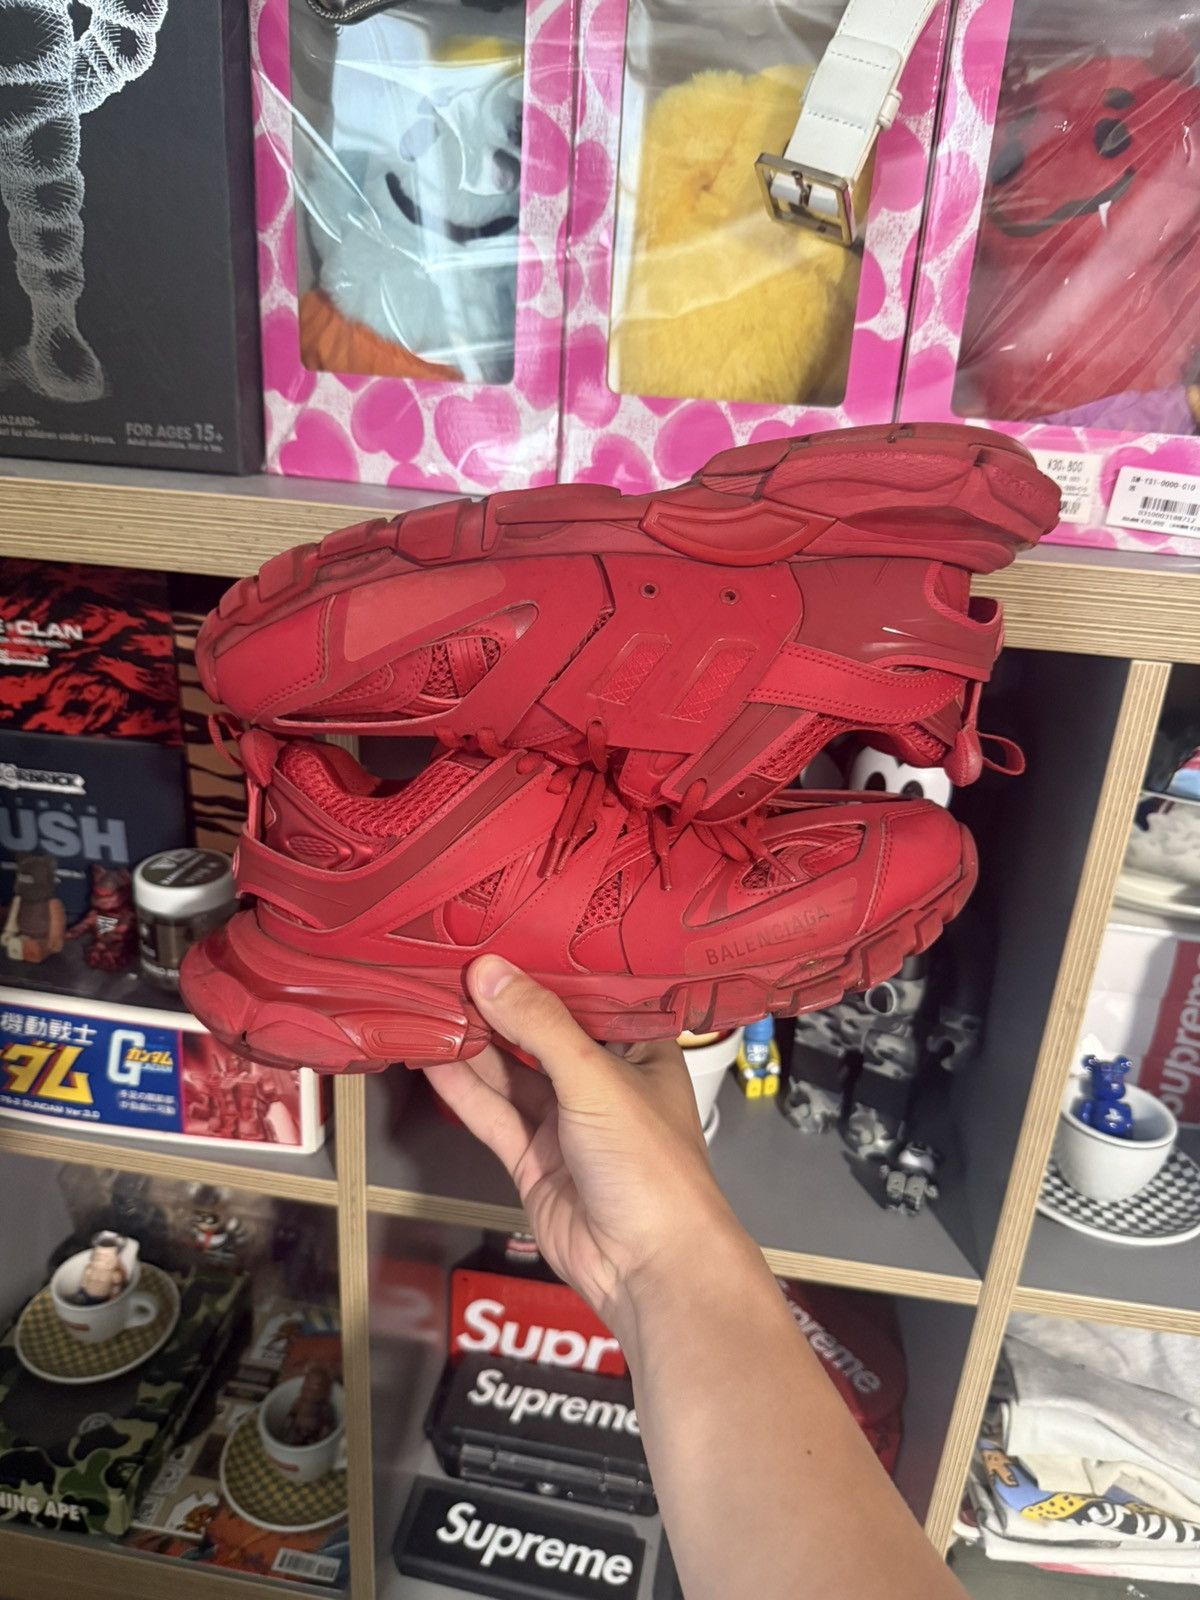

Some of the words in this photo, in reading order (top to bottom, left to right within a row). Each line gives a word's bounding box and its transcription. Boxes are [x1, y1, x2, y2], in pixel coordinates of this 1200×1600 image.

[126, 422, 154, 437] FOR
[157, 425, 192, 440] AGES
[194, 423, 224, 442] 15+
[705, 905, 830, 966] BALENCIAGA
[436, 1502, 634, 1585] Supreme
